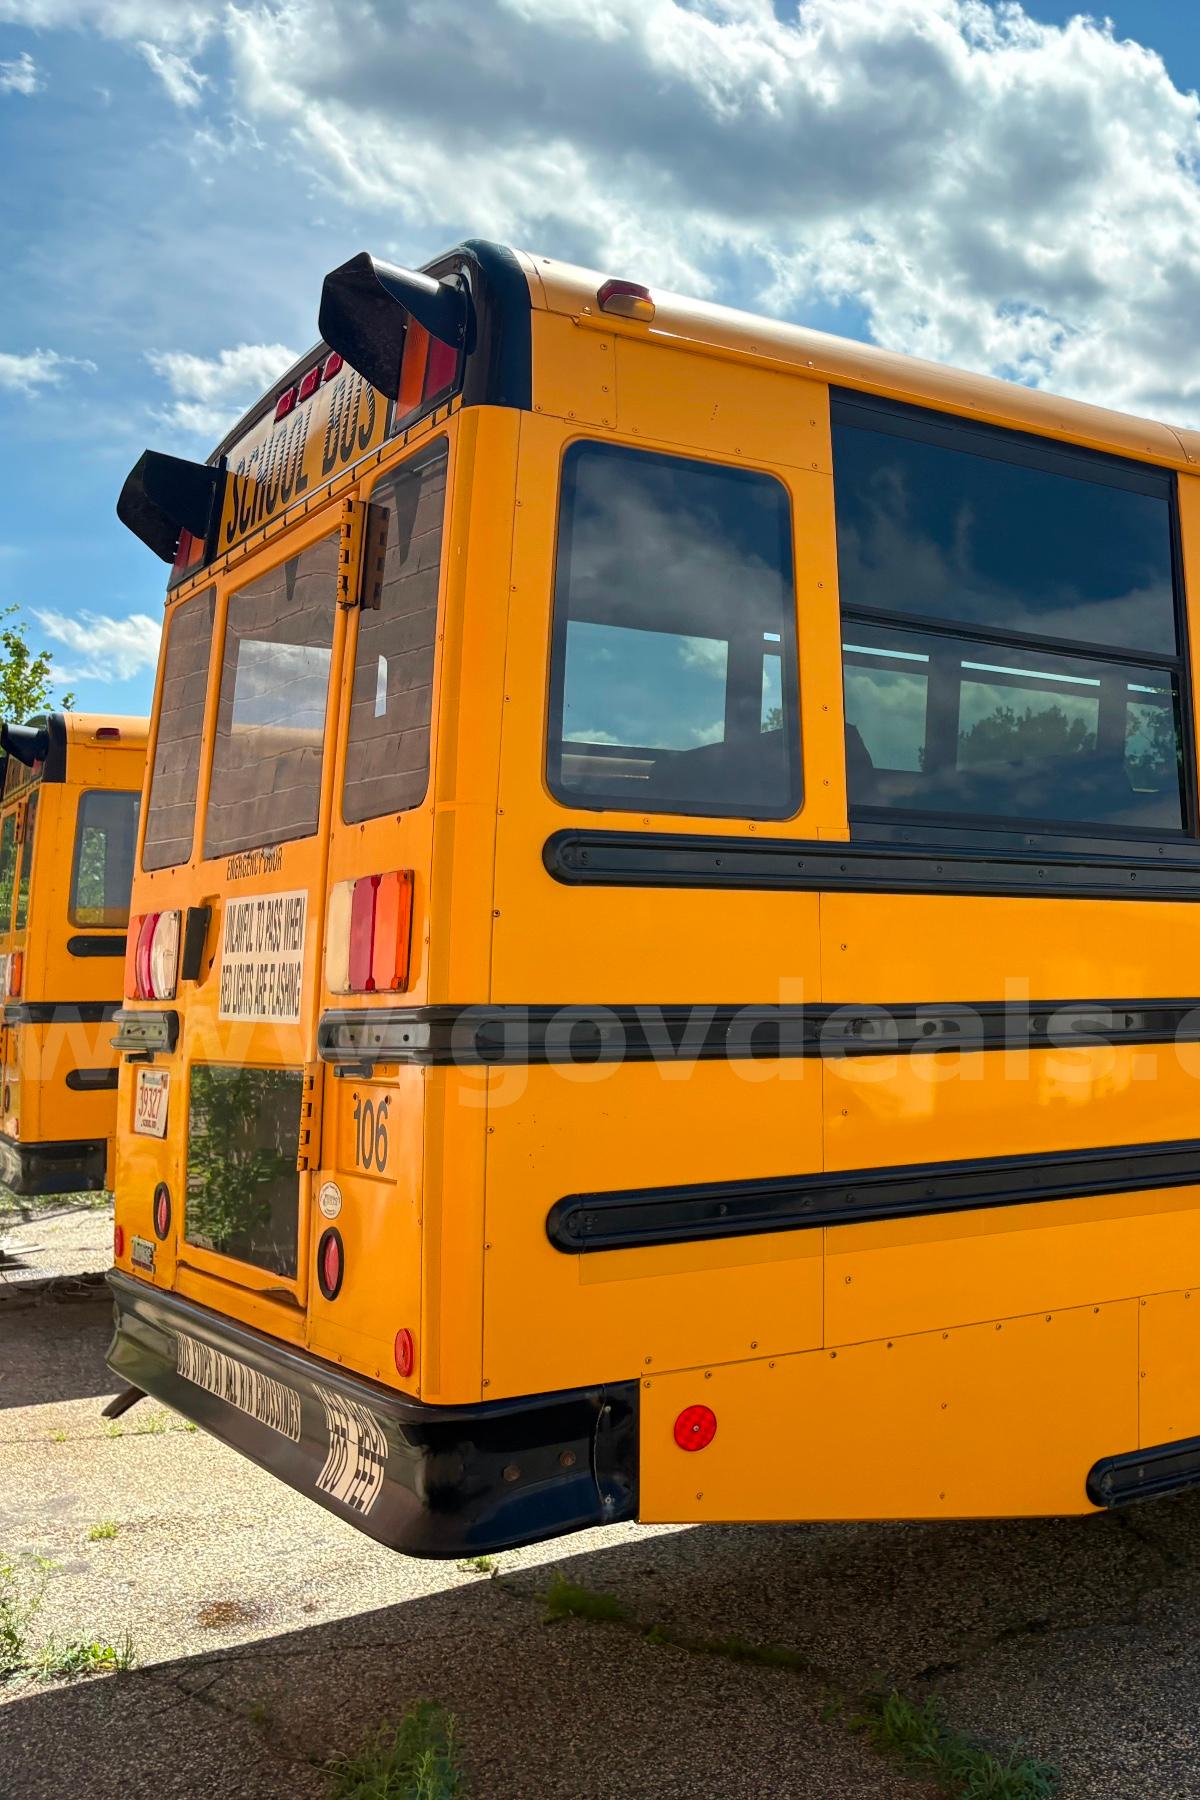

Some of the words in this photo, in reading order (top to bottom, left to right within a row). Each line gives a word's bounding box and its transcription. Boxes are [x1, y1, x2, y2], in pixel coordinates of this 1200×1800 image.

[227, 402, 313, 544] SCHOOL
[322, 371, 376, 477] BUS
[226, 850, 263, 881] EMERGENCY
[263, 847, 283, 874] DOOR
[225, 902, 255, 954] UNLAWFUL
[256, 900, 265, 953] TO
[265, 898, 283, 953] PASS
[284, 897, 305, 951] WHEN
[220, 964, 233, 1013] RED
[232, 963, 254, 1015] LIGHTS
[254, 963, 268, 1015] ARE
[268, 961, 301, 1017] FLASHING
[354, 1098, 388, 1173] 106
[178, 1331, 191, 1378] BUS
[193, 1340, 212, 1390] STOPS
[213, 1351, 221, 1396] AT
[255, 1371, 300, 1440] CROSSINGS
[312, 1383, 349, 1440] KEEP
[343, 1398, 386, 1458] BACK
[318, 1432, 348, 1493] 100
[342, 1445, 385, 1514] FEET
